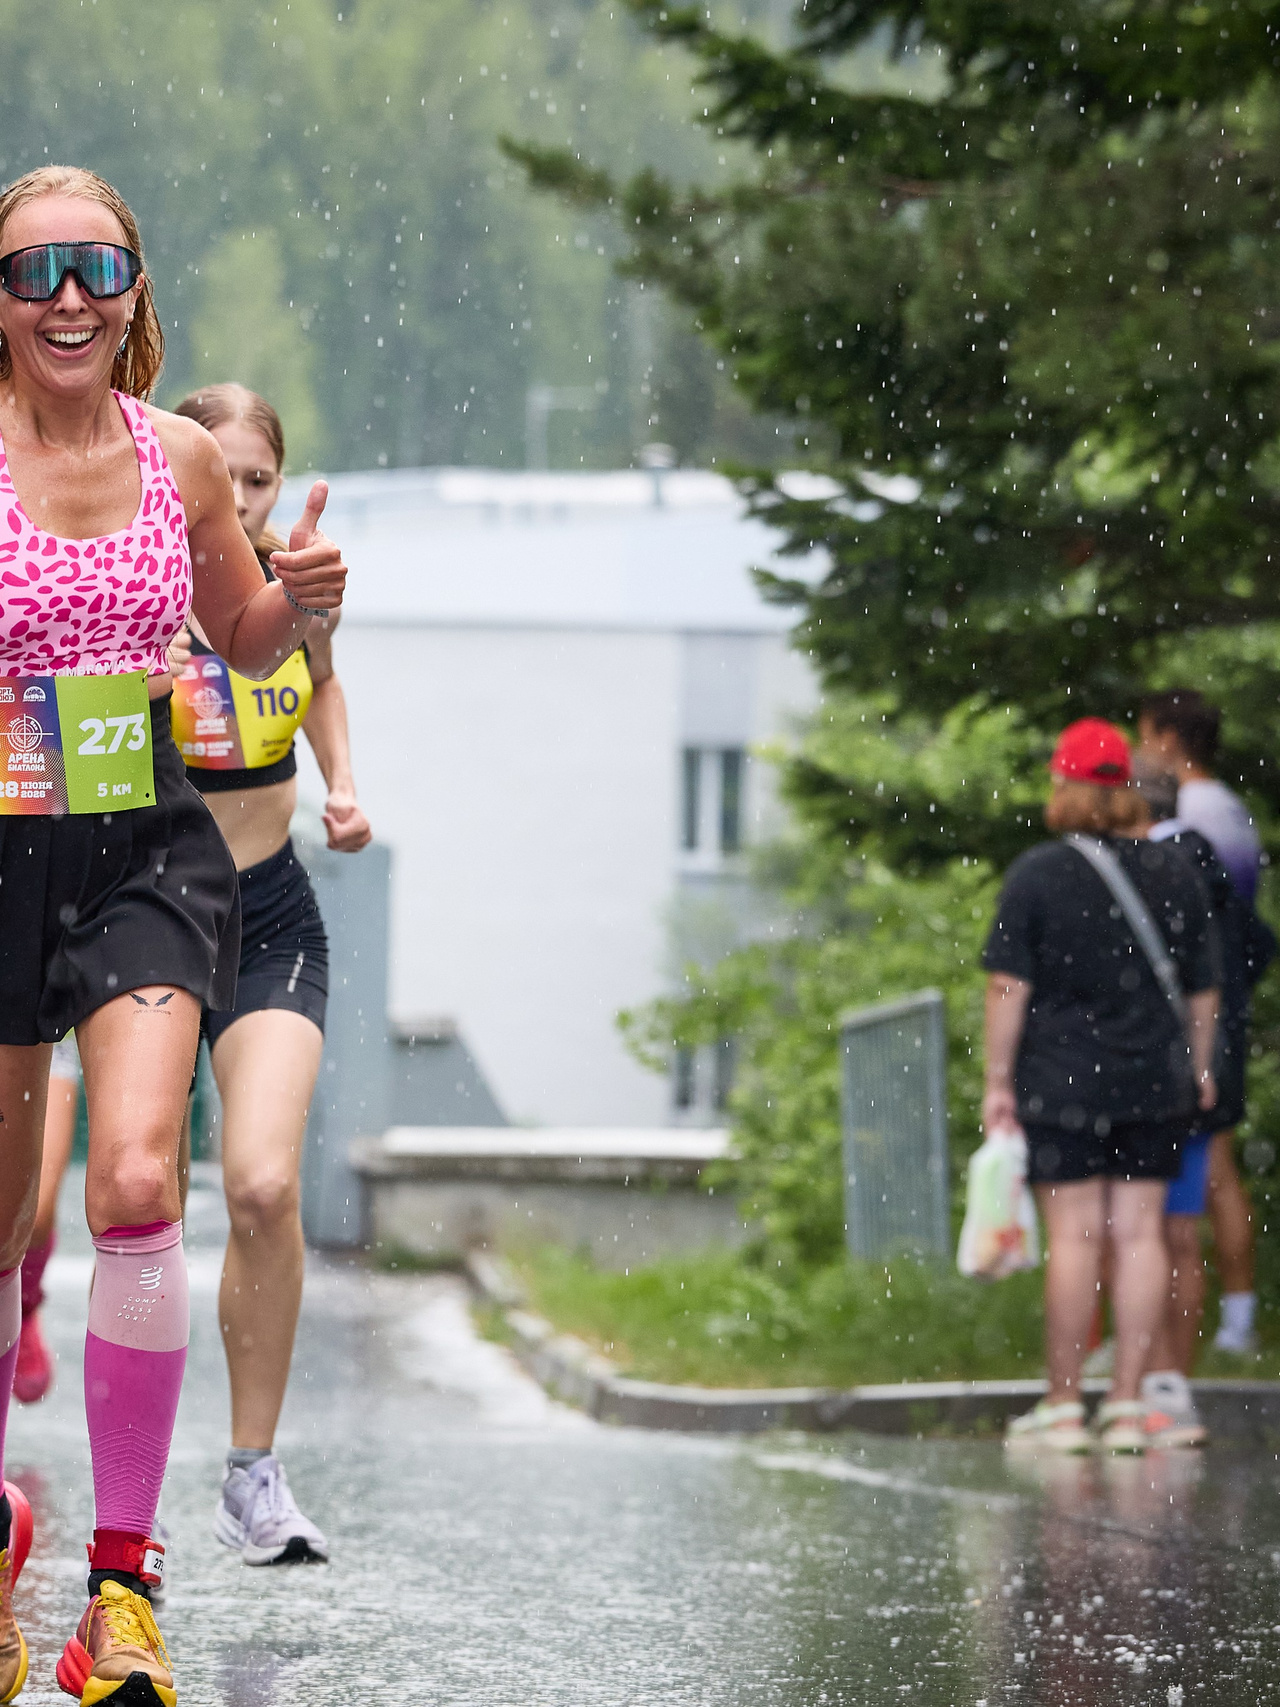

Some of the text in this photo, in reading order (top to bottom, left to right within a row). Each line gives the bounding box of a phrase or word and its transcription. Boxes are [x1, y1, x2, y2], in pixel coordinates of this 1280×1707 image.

[251, 686, 299, 717] 110
[78, 713, 146, 755] 273
[8, 753, 45, 764] АРЕНА
[7, 763, 46, 771] БИАТЛОНА
[20, 781, 54, 790] ИЮНЯ
[97, 783, 108, 798] 5
[127, 1296, 158, 1304] COMP
